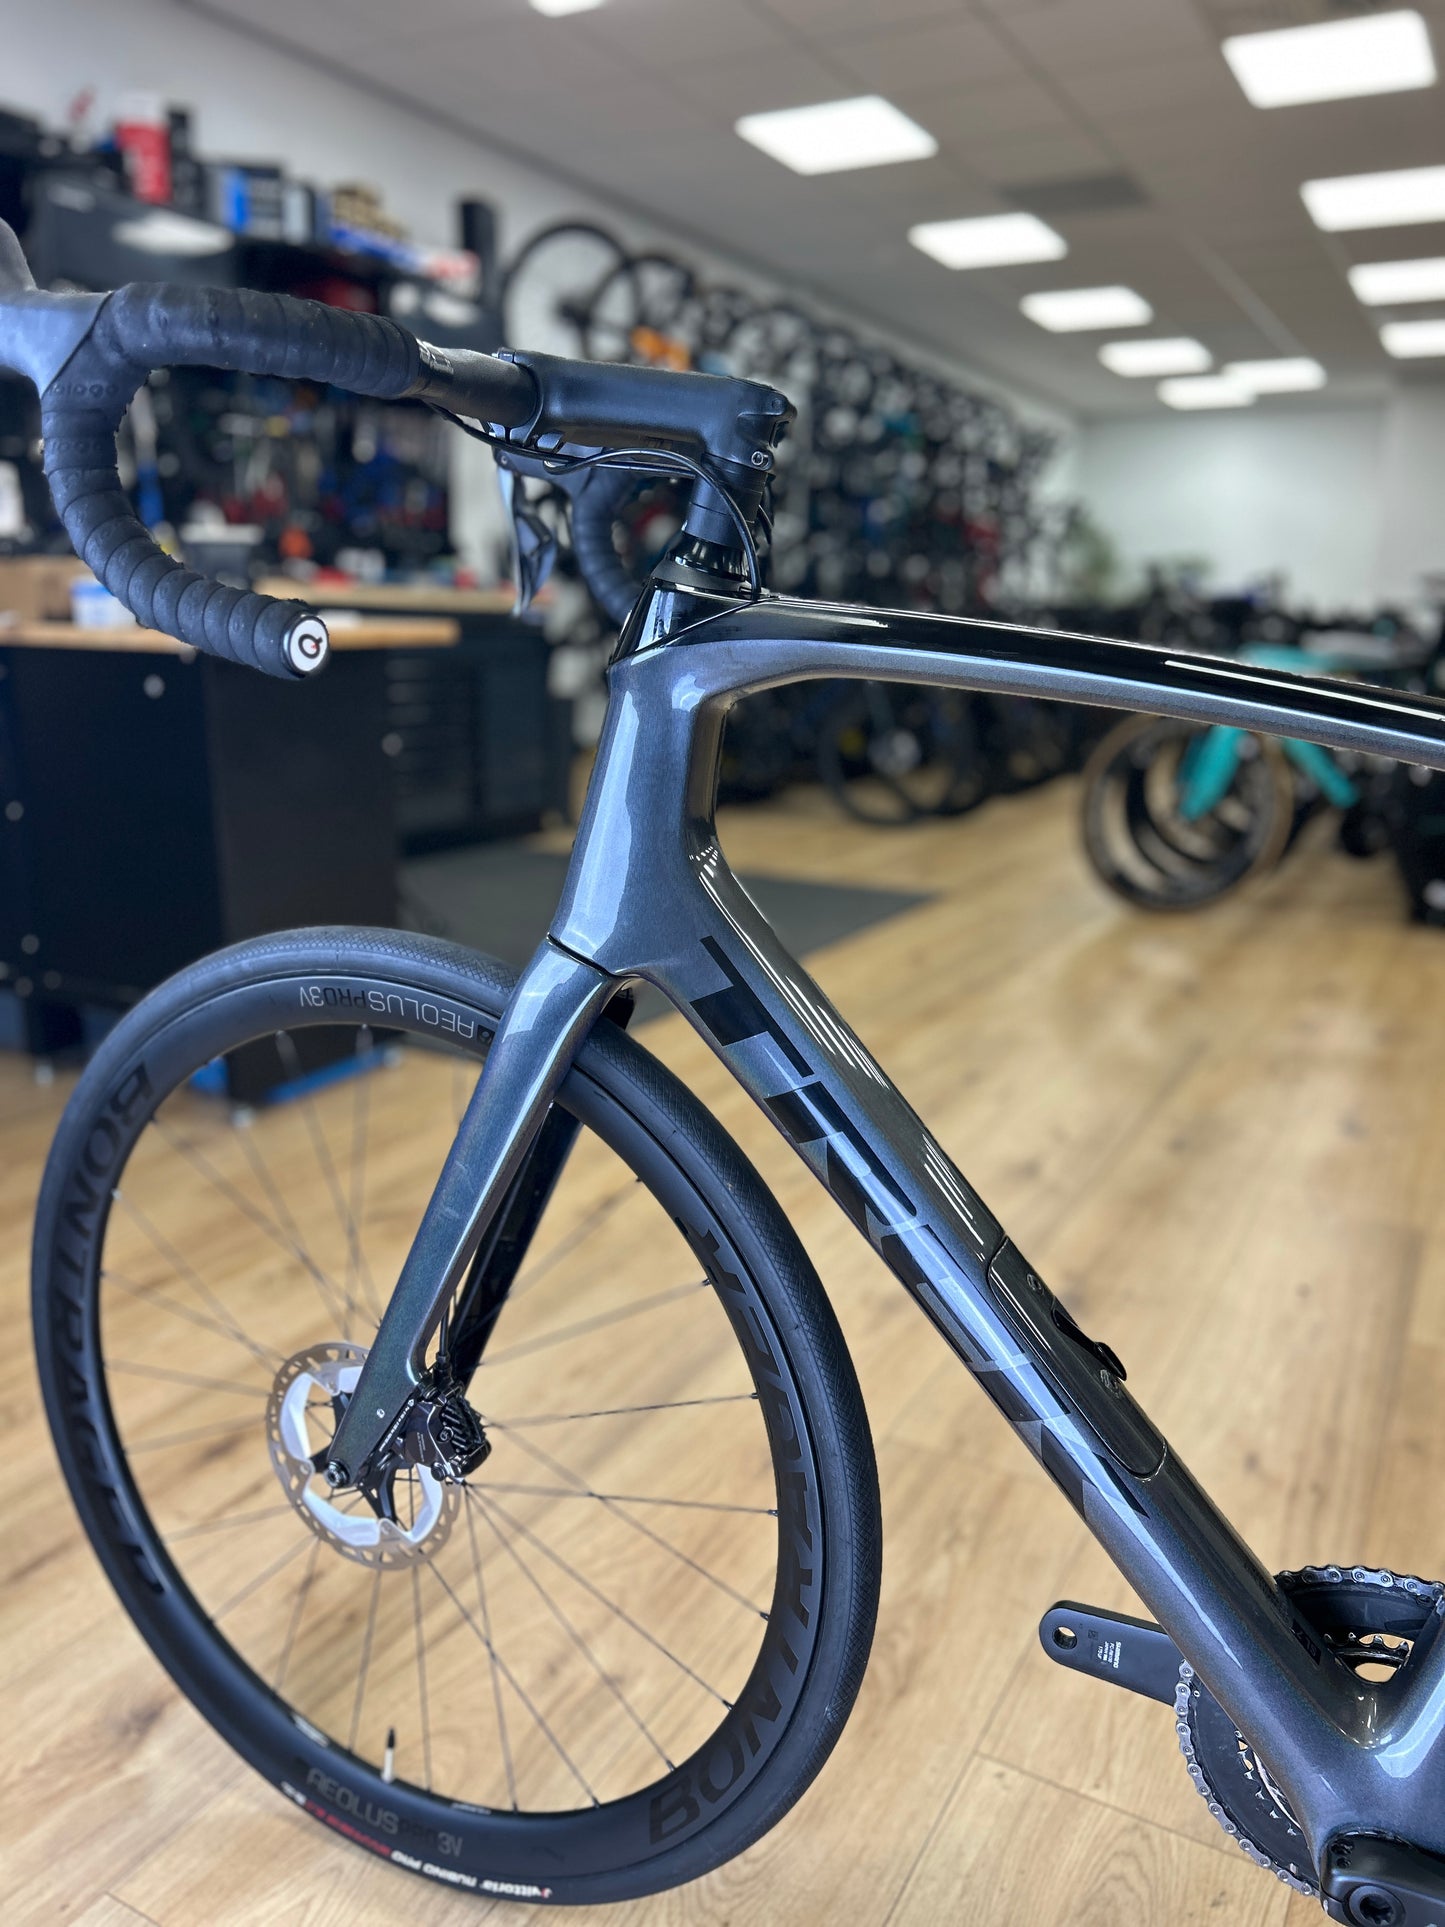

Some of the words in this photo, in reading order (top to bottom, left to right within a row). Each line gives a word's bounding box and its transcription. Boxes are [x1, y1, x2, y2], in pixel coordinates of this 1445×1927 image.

[368, 990, 475, 1039] AEOLUS
[689, 935, 1150, 1522] TREK
[307, 1767, 399, 1835] AEOLUS
